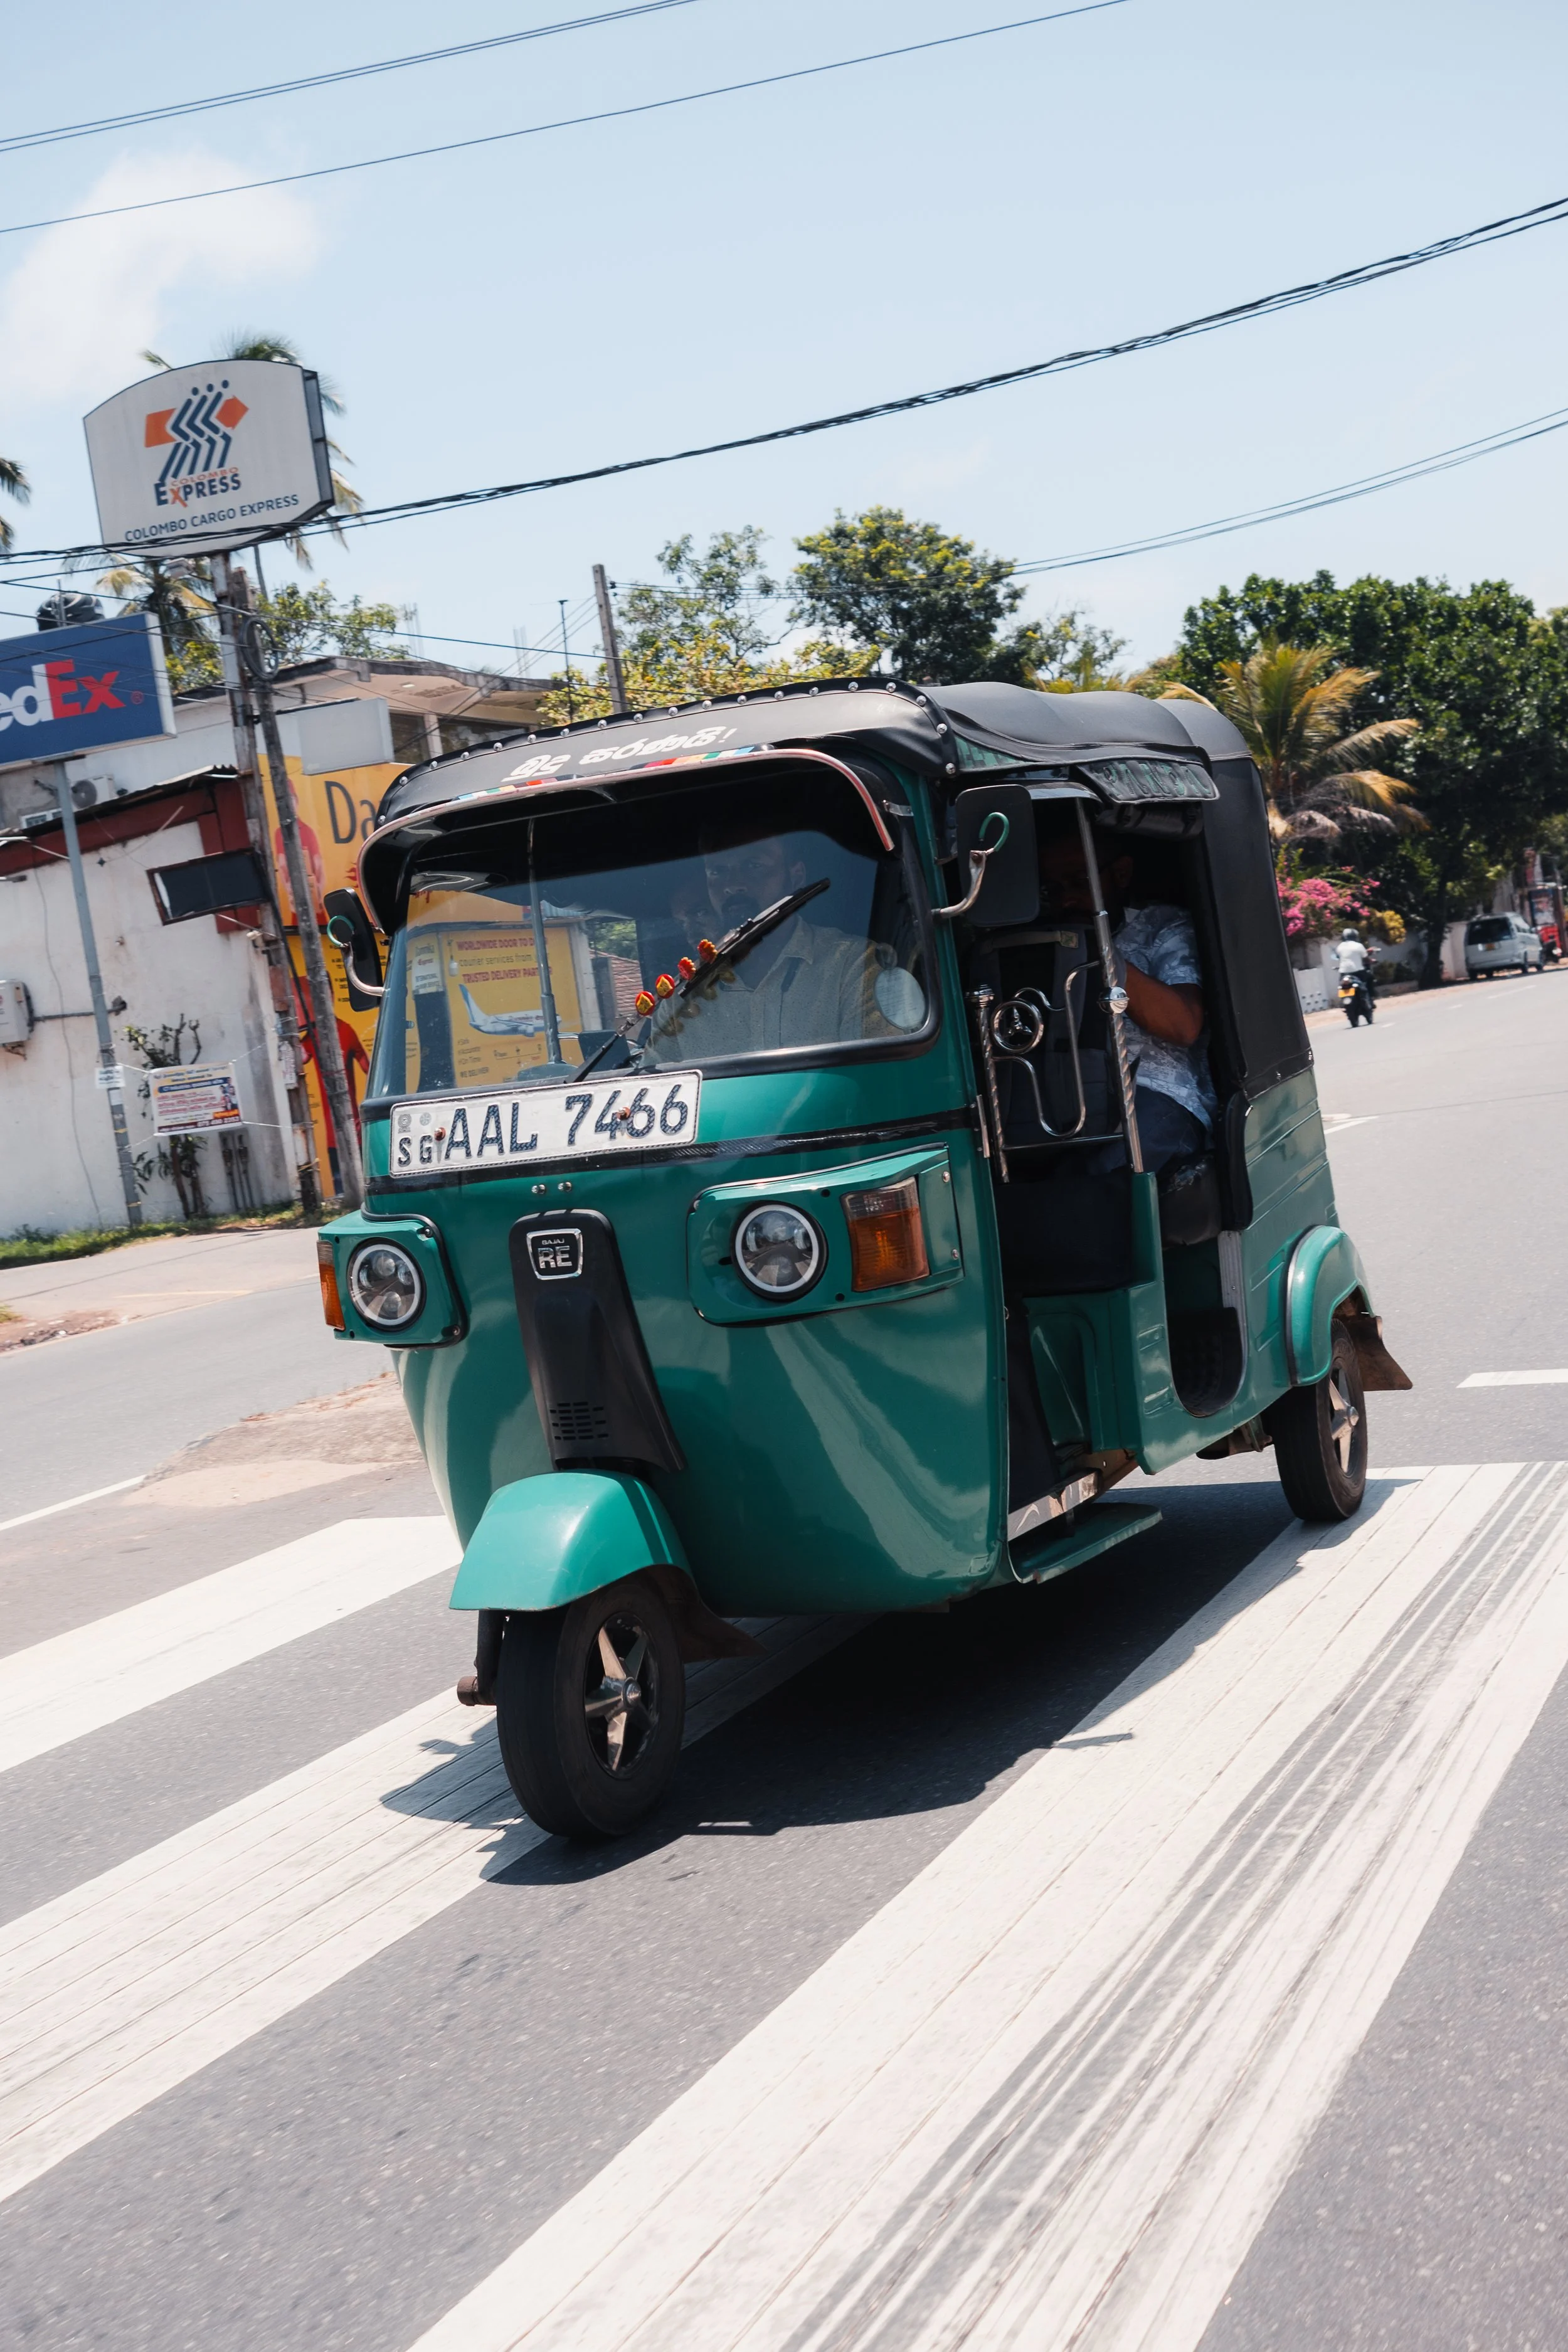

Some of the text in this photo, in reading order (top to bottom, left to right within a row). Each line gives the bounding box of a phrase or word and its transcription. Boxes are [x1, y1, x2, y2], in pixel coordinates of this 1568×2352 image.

[154, 473, 241, 508] EXPRESS
[170, 467, 238, 487] COLOMBO
[125, 494, 299, 541] COLOMBO CARGO EXPRESS
[397, 1083, 689, 1167] SG AAL 7466
[538, 1245, 572, 1268] RE
